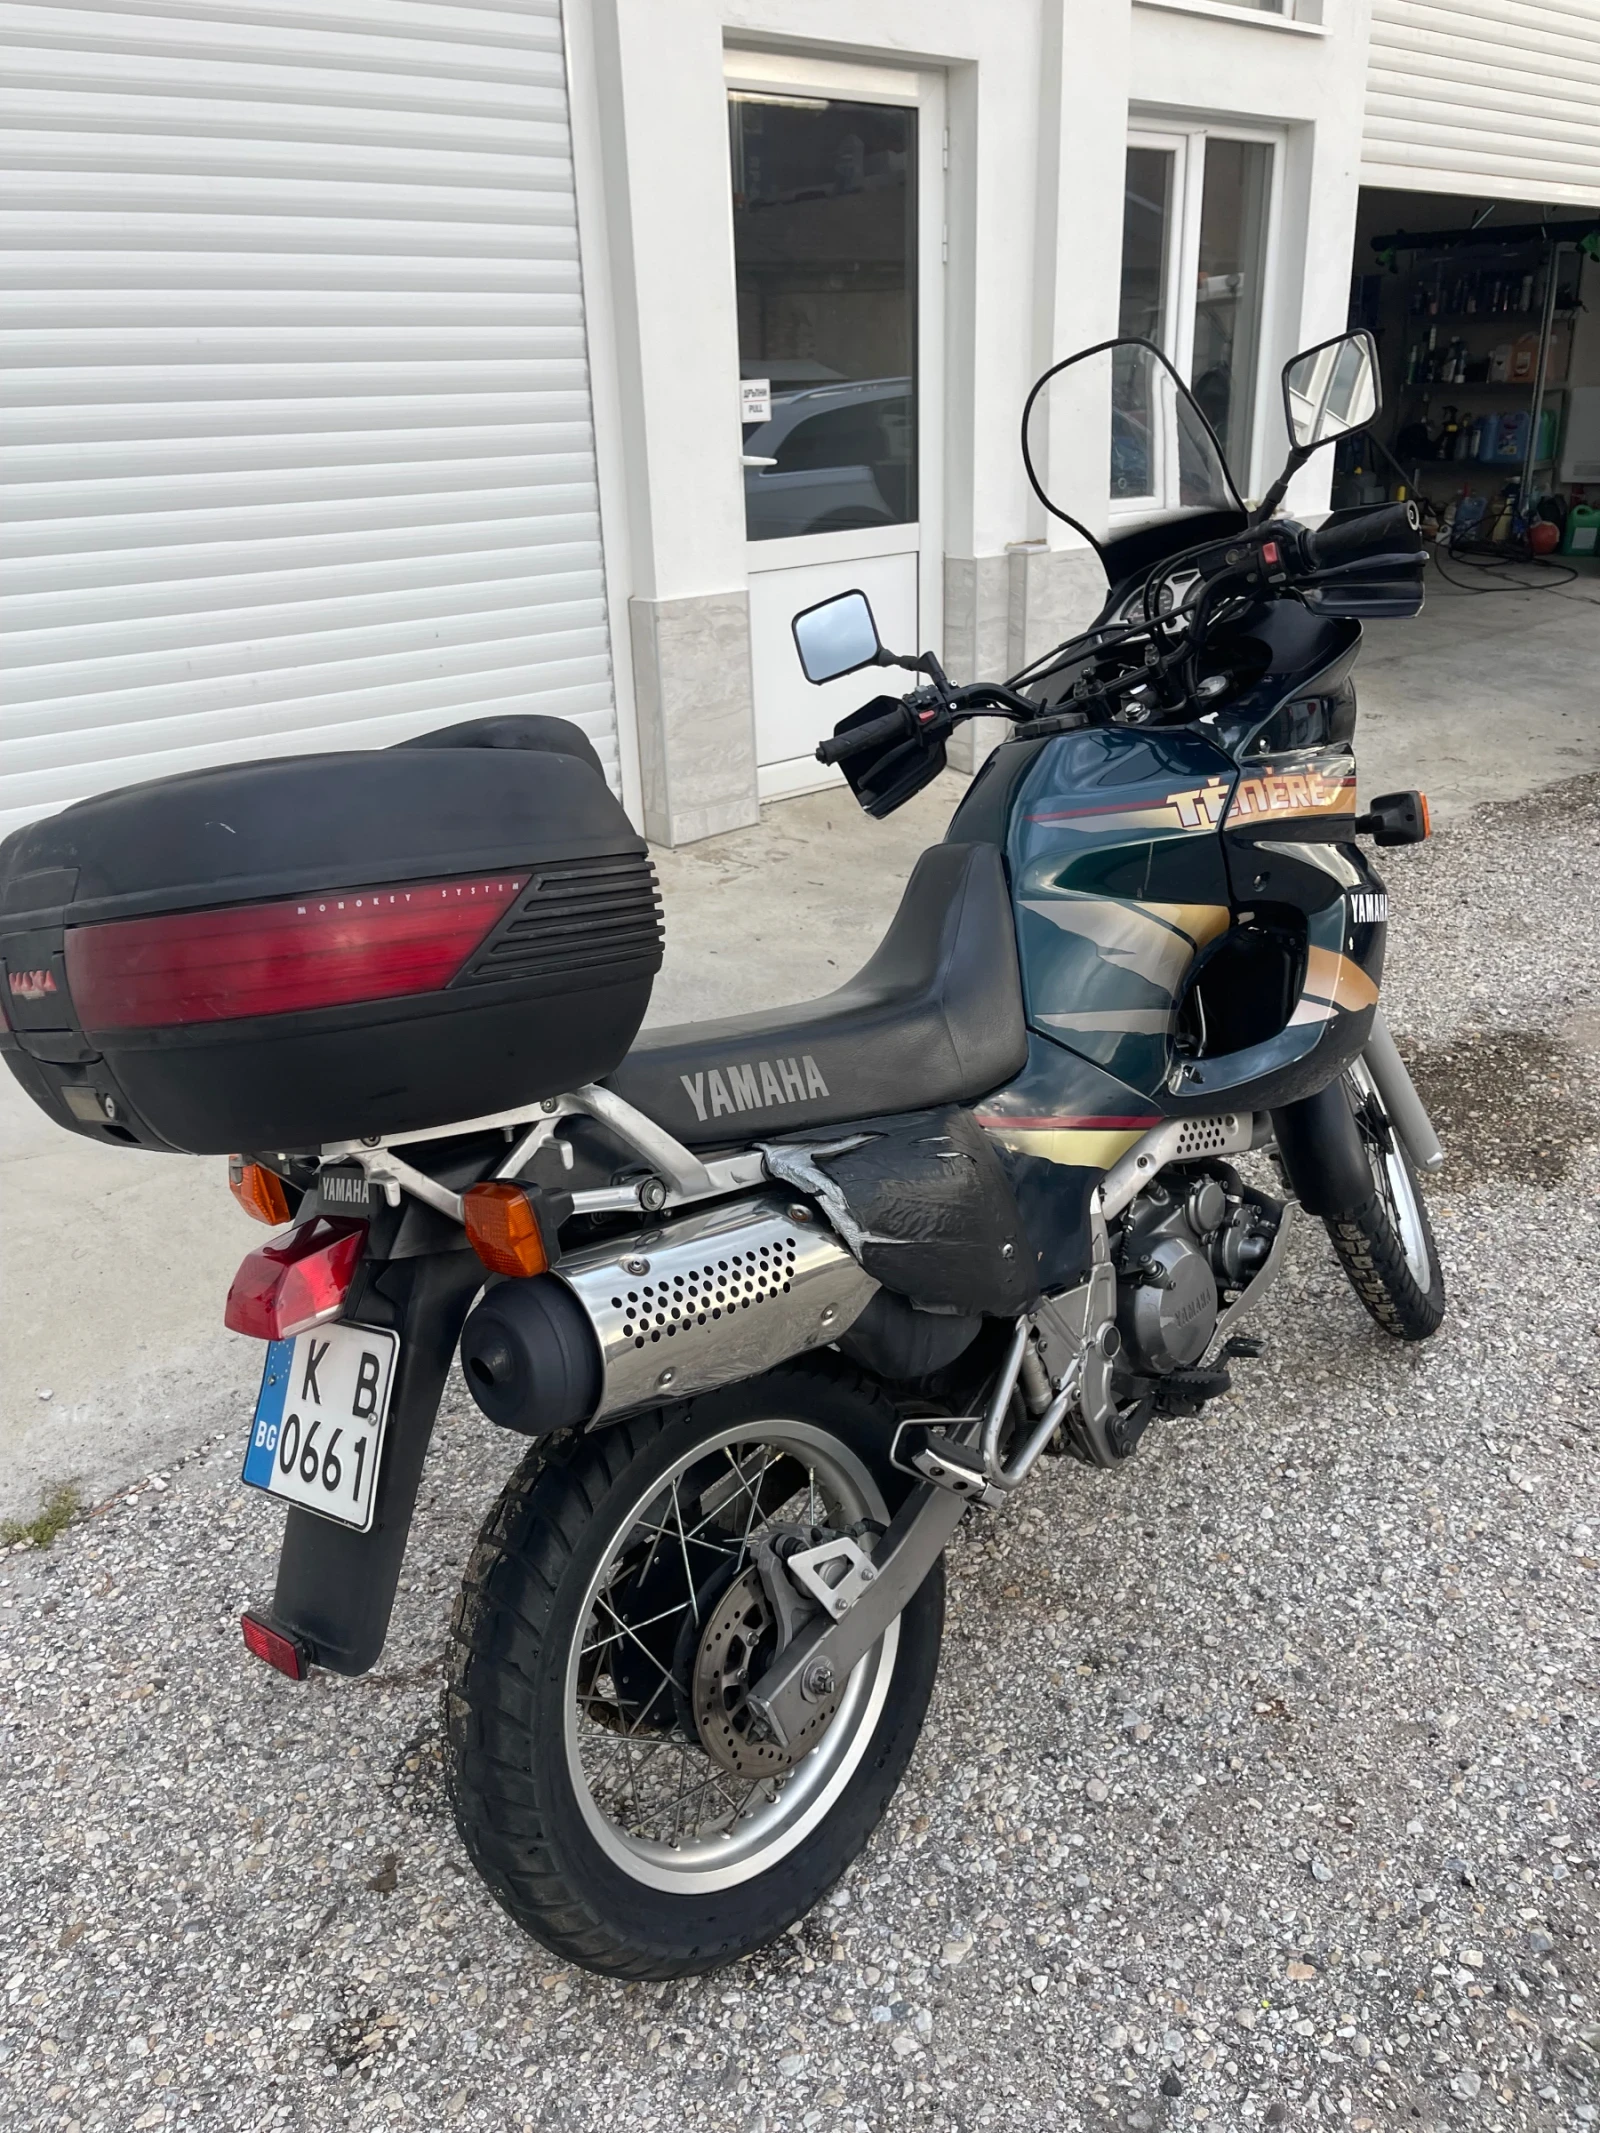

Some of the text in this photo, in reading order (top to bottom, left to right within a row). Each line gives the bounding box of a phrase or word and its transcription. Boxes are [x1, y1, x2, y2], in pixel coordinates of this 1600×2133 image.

[748, 404, 764, 414] PULL
[297, 882, 520, 915] MONOKEY SYSTEM
[679, 1055, 830, 1122] YAMAHA
[322, 1176, 370, 1204] YAMAHA
[1174, 1287, 1212, 1329] YAMAHA
[301, 1338, 381, 1419] K B
[254, 1420, 278, 1451] BG
[279, 1413, 368, 1502] 0661
